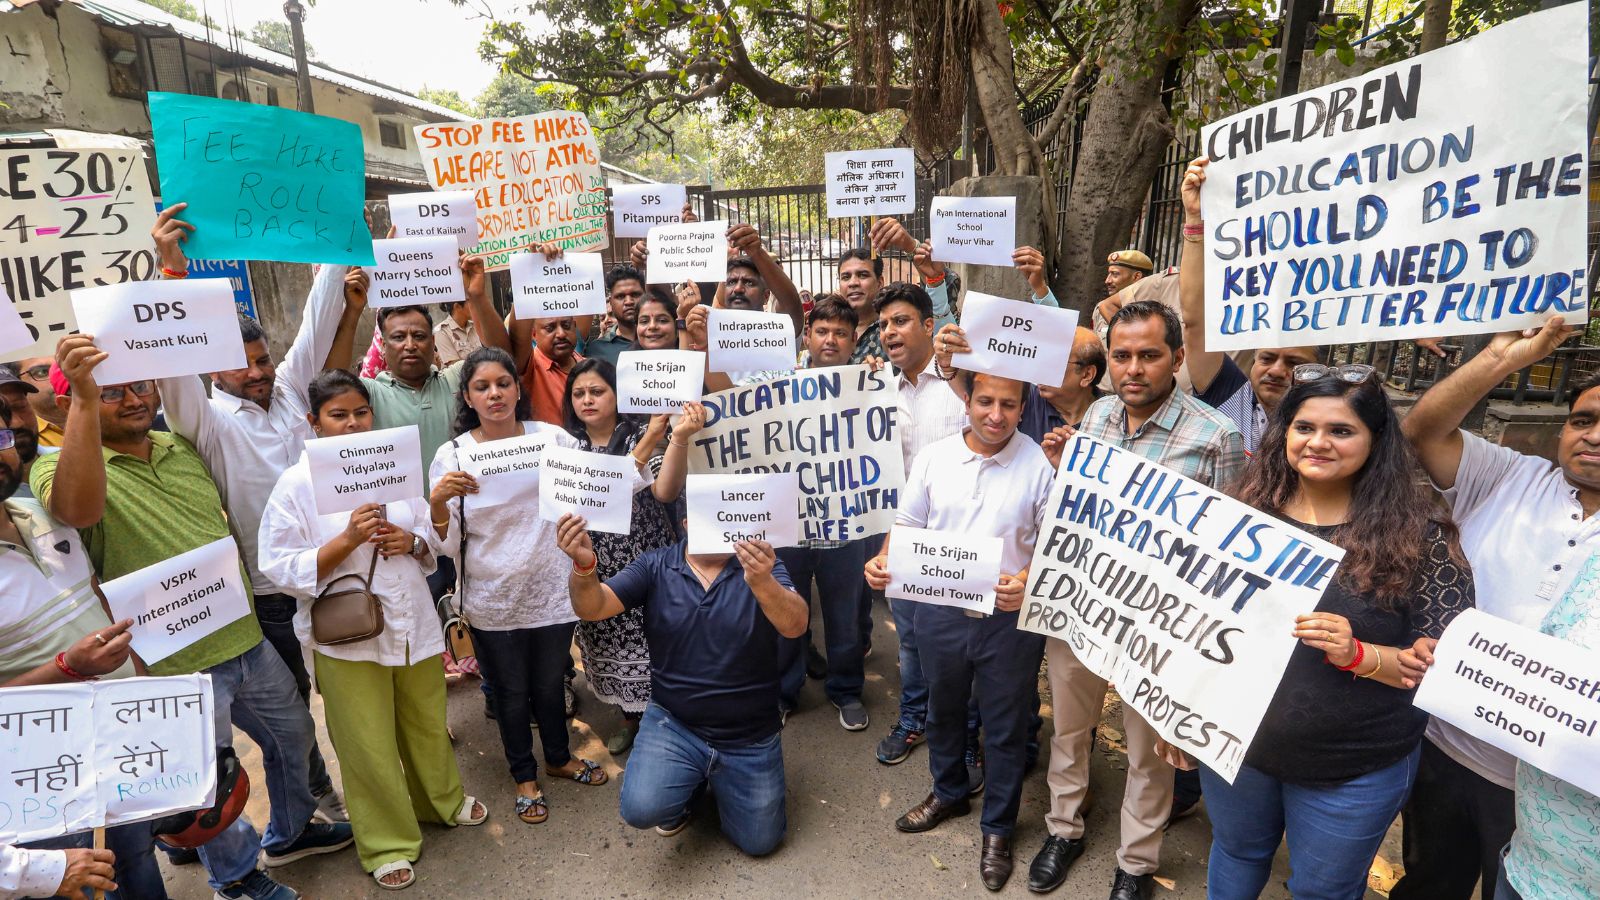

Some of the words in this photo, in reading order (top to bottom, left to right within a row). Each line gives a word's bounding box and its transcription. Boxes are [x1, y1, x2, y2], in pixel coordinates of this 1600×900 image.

[1207, 64, 1422, 163] CHILDREN
[421, 123, 483, 148] STOP
[491, 121, 525, 143] FEE
[533, 116, 588, 143] HIKES
[183, 116, 249, 162] FEE
[275, 133, 345, 172] HIKE
[511, 150, 540, 176] NOT
[846, 160, 867, 169] शिक्षा
[871, 159, 893, 169] हमारा
[1235, 124, 1474, 209] EDUCATION
[43, 151, 135, 200] 30%
[836, 171, 864, 182] मौलिक
[238, 172, 329, 215] ROLL
[474, 187, 493, 209] KE
[500, 172, 584, 207] EDUCATION
[844, 183, 868, 193] लेकिन
[874, 182, 898, 192] आपने
[641, 195, 661, 205] SPS
[836, 197, 860, 206] बनाया
[863, 195, 876, 206] इसे
[880, 195, 906, 203] व्यापार
[1213, 194, 1389, 260] SHOULD
[1422, 174, 1481, 224] BE
[1494, 152, 1583, 208] THE
[418, 204, 450, 217] DPS
[477, 207, 526, 239] ORDALE
[528, 206, 541, 227] TO
[548, 199, 573, 224] ALL
[573, 205, 590, 218] OUR
[622, 212, 680, 225] Pitampura
[936, 209, 953, 220] Ryan
[955, 209, 1007, 218] International
[0, 202, 134, 243] 4-25
[405, 227, 423, 236] East
[426, 227, 435, 235] of
[437, 226, 467, 235] Kailash
[957, 222, 983, 232] School
[510, 236, 518, 248] IS
[540, 228, 557, 242] KEY
[558, 226, 573, 237] TO
[575, 222, 589, 233] ALL
[589, 218, 603, 230] THE
[658, 233, 687, 243] Poorna
[689, 231, 715, 243] Prajna
[947, 236, 972, 247] Mayur
[973, 237, 995, 246] Vihar
[388, 251, 434, 263] Queens
[660, 246, 684, 256] Public
[686, 245, 713, 255] School
[542, 264, 572, 276] Sneh
[664, 259, 688, 269] Vasant
[690, 258, 708, 269] Kunj
[1222, 260, 1278, 300] KEY
[1287, 252, 1362, 297] YOU
[1369, 238, 1468, 287] NEED
[1478, 227, 1538, 271] TO
[374, 270, 410, 281] Marry
[414, 266, 452, 279] School
[380, 286, 418, 299] Model
[421, 285, 452, 297] Town
[523, 280, 595, 295] International
[133, 300, 187, 323] DPS
[542, 299, 579, 311] School
[1219, 301, 1271, 335] UR
[1281, 289, 1428, 332] BETTER
[1434, 269, 1586, 324] FUTURE
[718, 321, 784, 332] Indraprastha
[1001, 315, 1033, 332] DPS
[124, 336, 173, 351] Vasant
[177, 332, 209, 348] Kunj
[718, 338, 750, 349] World
[753, 337, 788, 348] School
[986, 337, 1038, 359] Rohini
[634, 361, 653, 372] The
[656, 362, 686, 374] Srijan
[642, 379, 676, 389] School
[629, 397, 662, 407] Model
[664, 398, 691, 407] Tow
[701, 372, 841, 429] DUCATION
[857, 370, 886, 391] IS
[695, 428, 751, 468] THE
[763, 407, 860, 457] RIGHT
[866, 405, 898, 442] OF
[339, 442, 395, 460] Chinmaya
[342, 459, 396, 477] Vidyalaya
[481, 463, 510, 477] Global
[546, 458, 582, 475] Maharaja
[584, 466, 623, 479] Agrasen
[796, 455, 881, 495] CHILD
[334, 473, 407, 495] VashantVihar
[554, 477, 576, 489] public
[578, 481, 610, 493] School
[554, 492, 577, 504] Ashok
[580, 497, 606, 508] Vihar
[721, 490, 765, 501] Lancer
[798, 495, 830, 520] LAY
[841, 488, 898, 518] WITH
[716, 510, 772, 522] Convent
[1067, 436, 1121, 485] FEE
[1120, 462, 1221, 535] HIKE
[1218, 514, 1275, 563] IS
[1264, 534, 1340, 591] THE
[912, 542, 937, 556] The
[940, 545, 978, 562] Srijan
[1056, 484, 1272, 614] HARRASMENT
[160, 568, 198, 592] VSPK
[920, 564, 965, 580] School
[137, 577, 226, 627] International
[902, 583, 945, 598] Model
[947, 588, 984, 603] Town
[165, 605, 212, 636] School
[1030, 568, 1172, 676] EDUCATION
[1468, 631, 1600, 703] Indraprasth
[1455, 660, 1597, 737] International
[0, 707, 72, 736] गना
[111, 693, 204, 724] लगान
[1474, 704, 1546, 747] school
[11, 754, 84, 793] नहीं
[114, 741, 169, 778] देंगे
[117, 772, 200, 802] ROHINI
